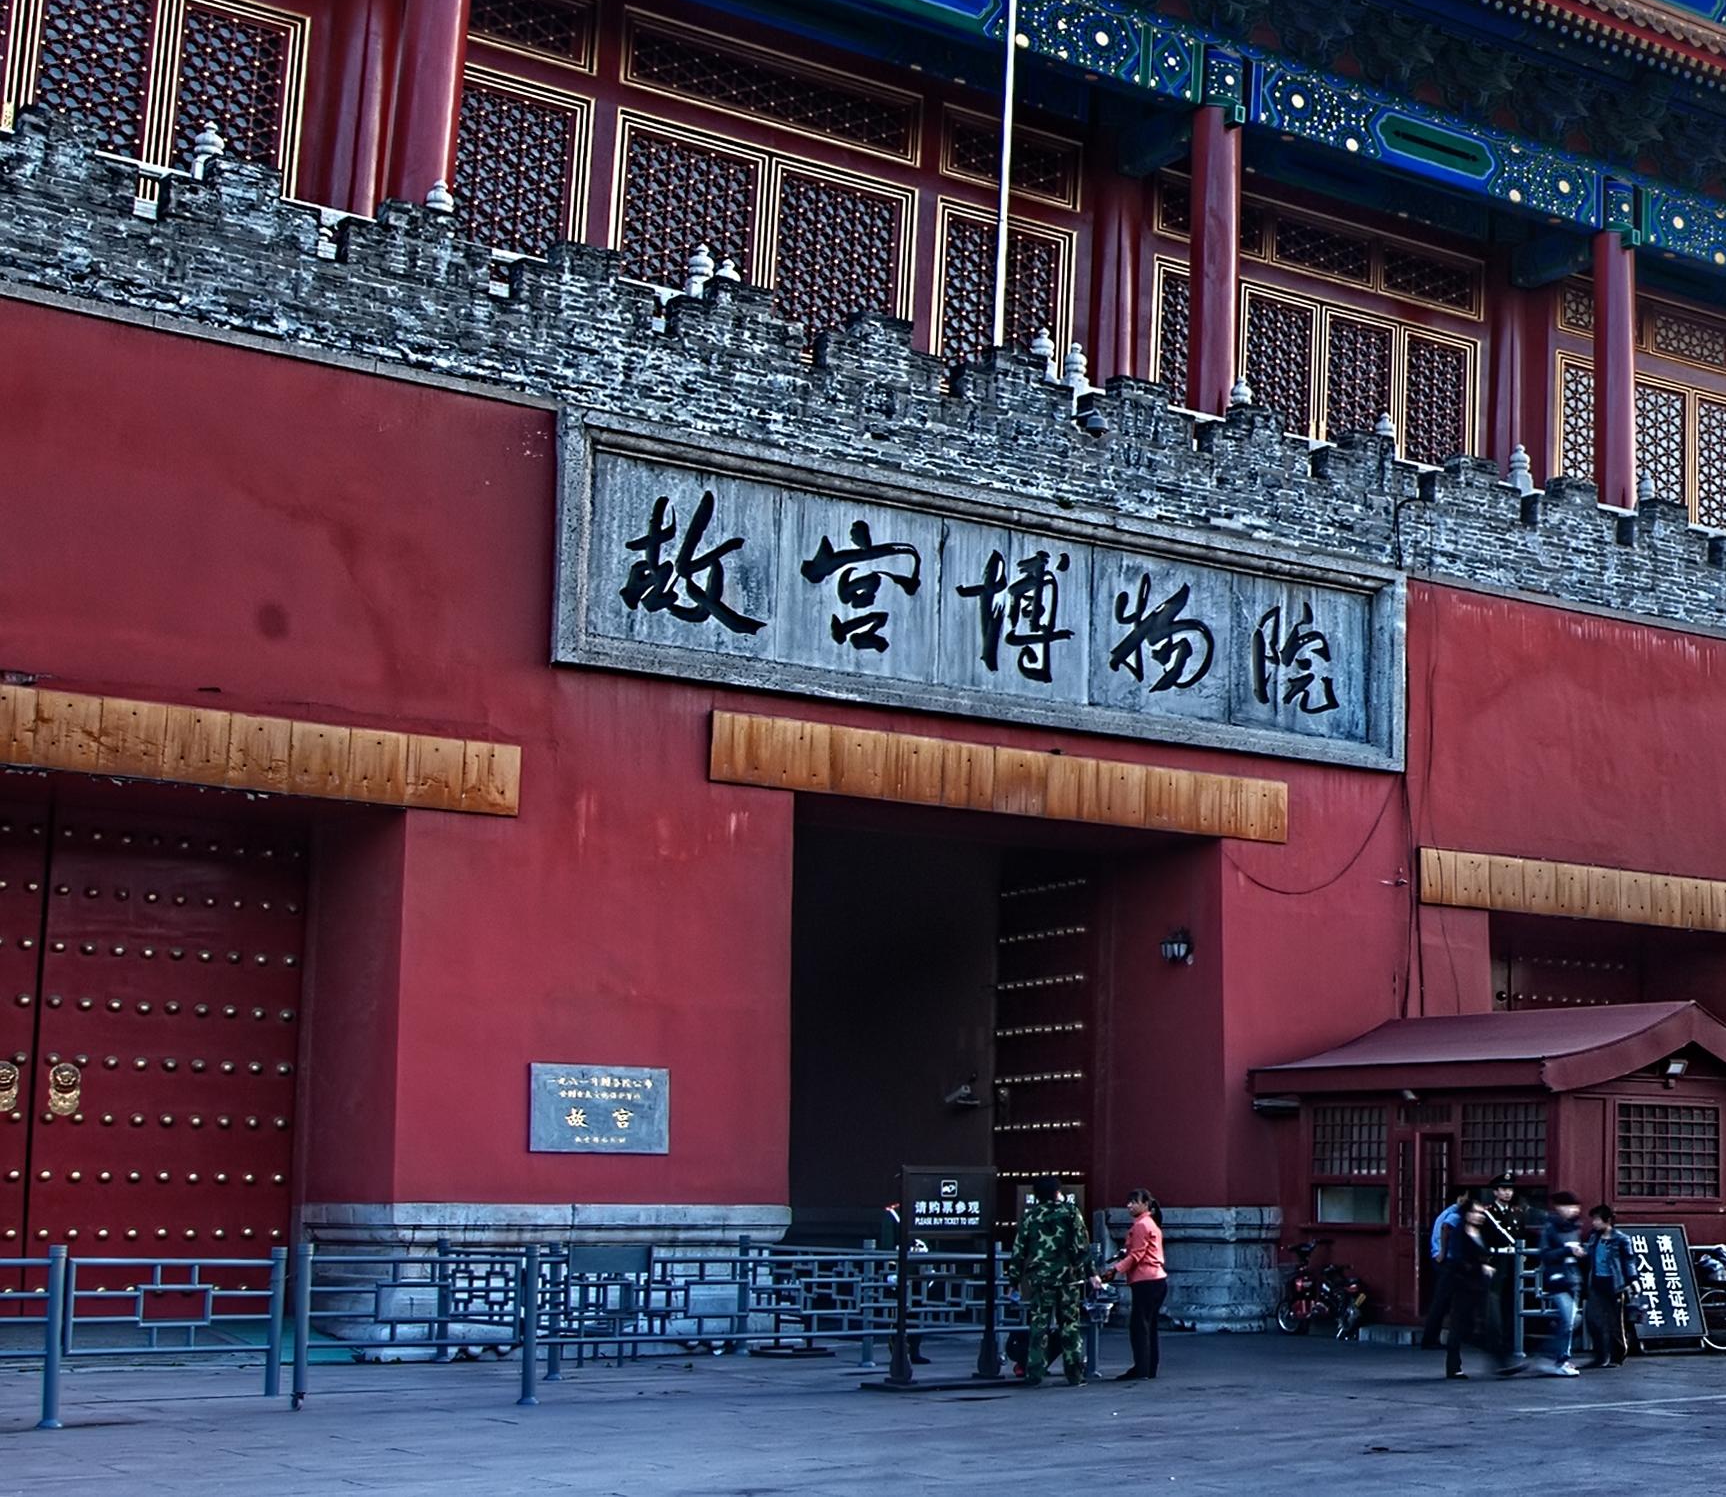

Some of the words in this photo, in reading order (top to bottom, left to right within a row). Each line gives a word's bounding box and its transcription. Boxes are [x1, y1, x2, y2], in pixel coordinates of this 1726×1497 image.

[619, 490, 1341, 714] 故宫博物院
[914, 1200, 980, 1214] 请购票参观
[1631, 1234, 1665, 1327] 出入请下车
[1656, 1234, 1690, 1327] 请出示证件
